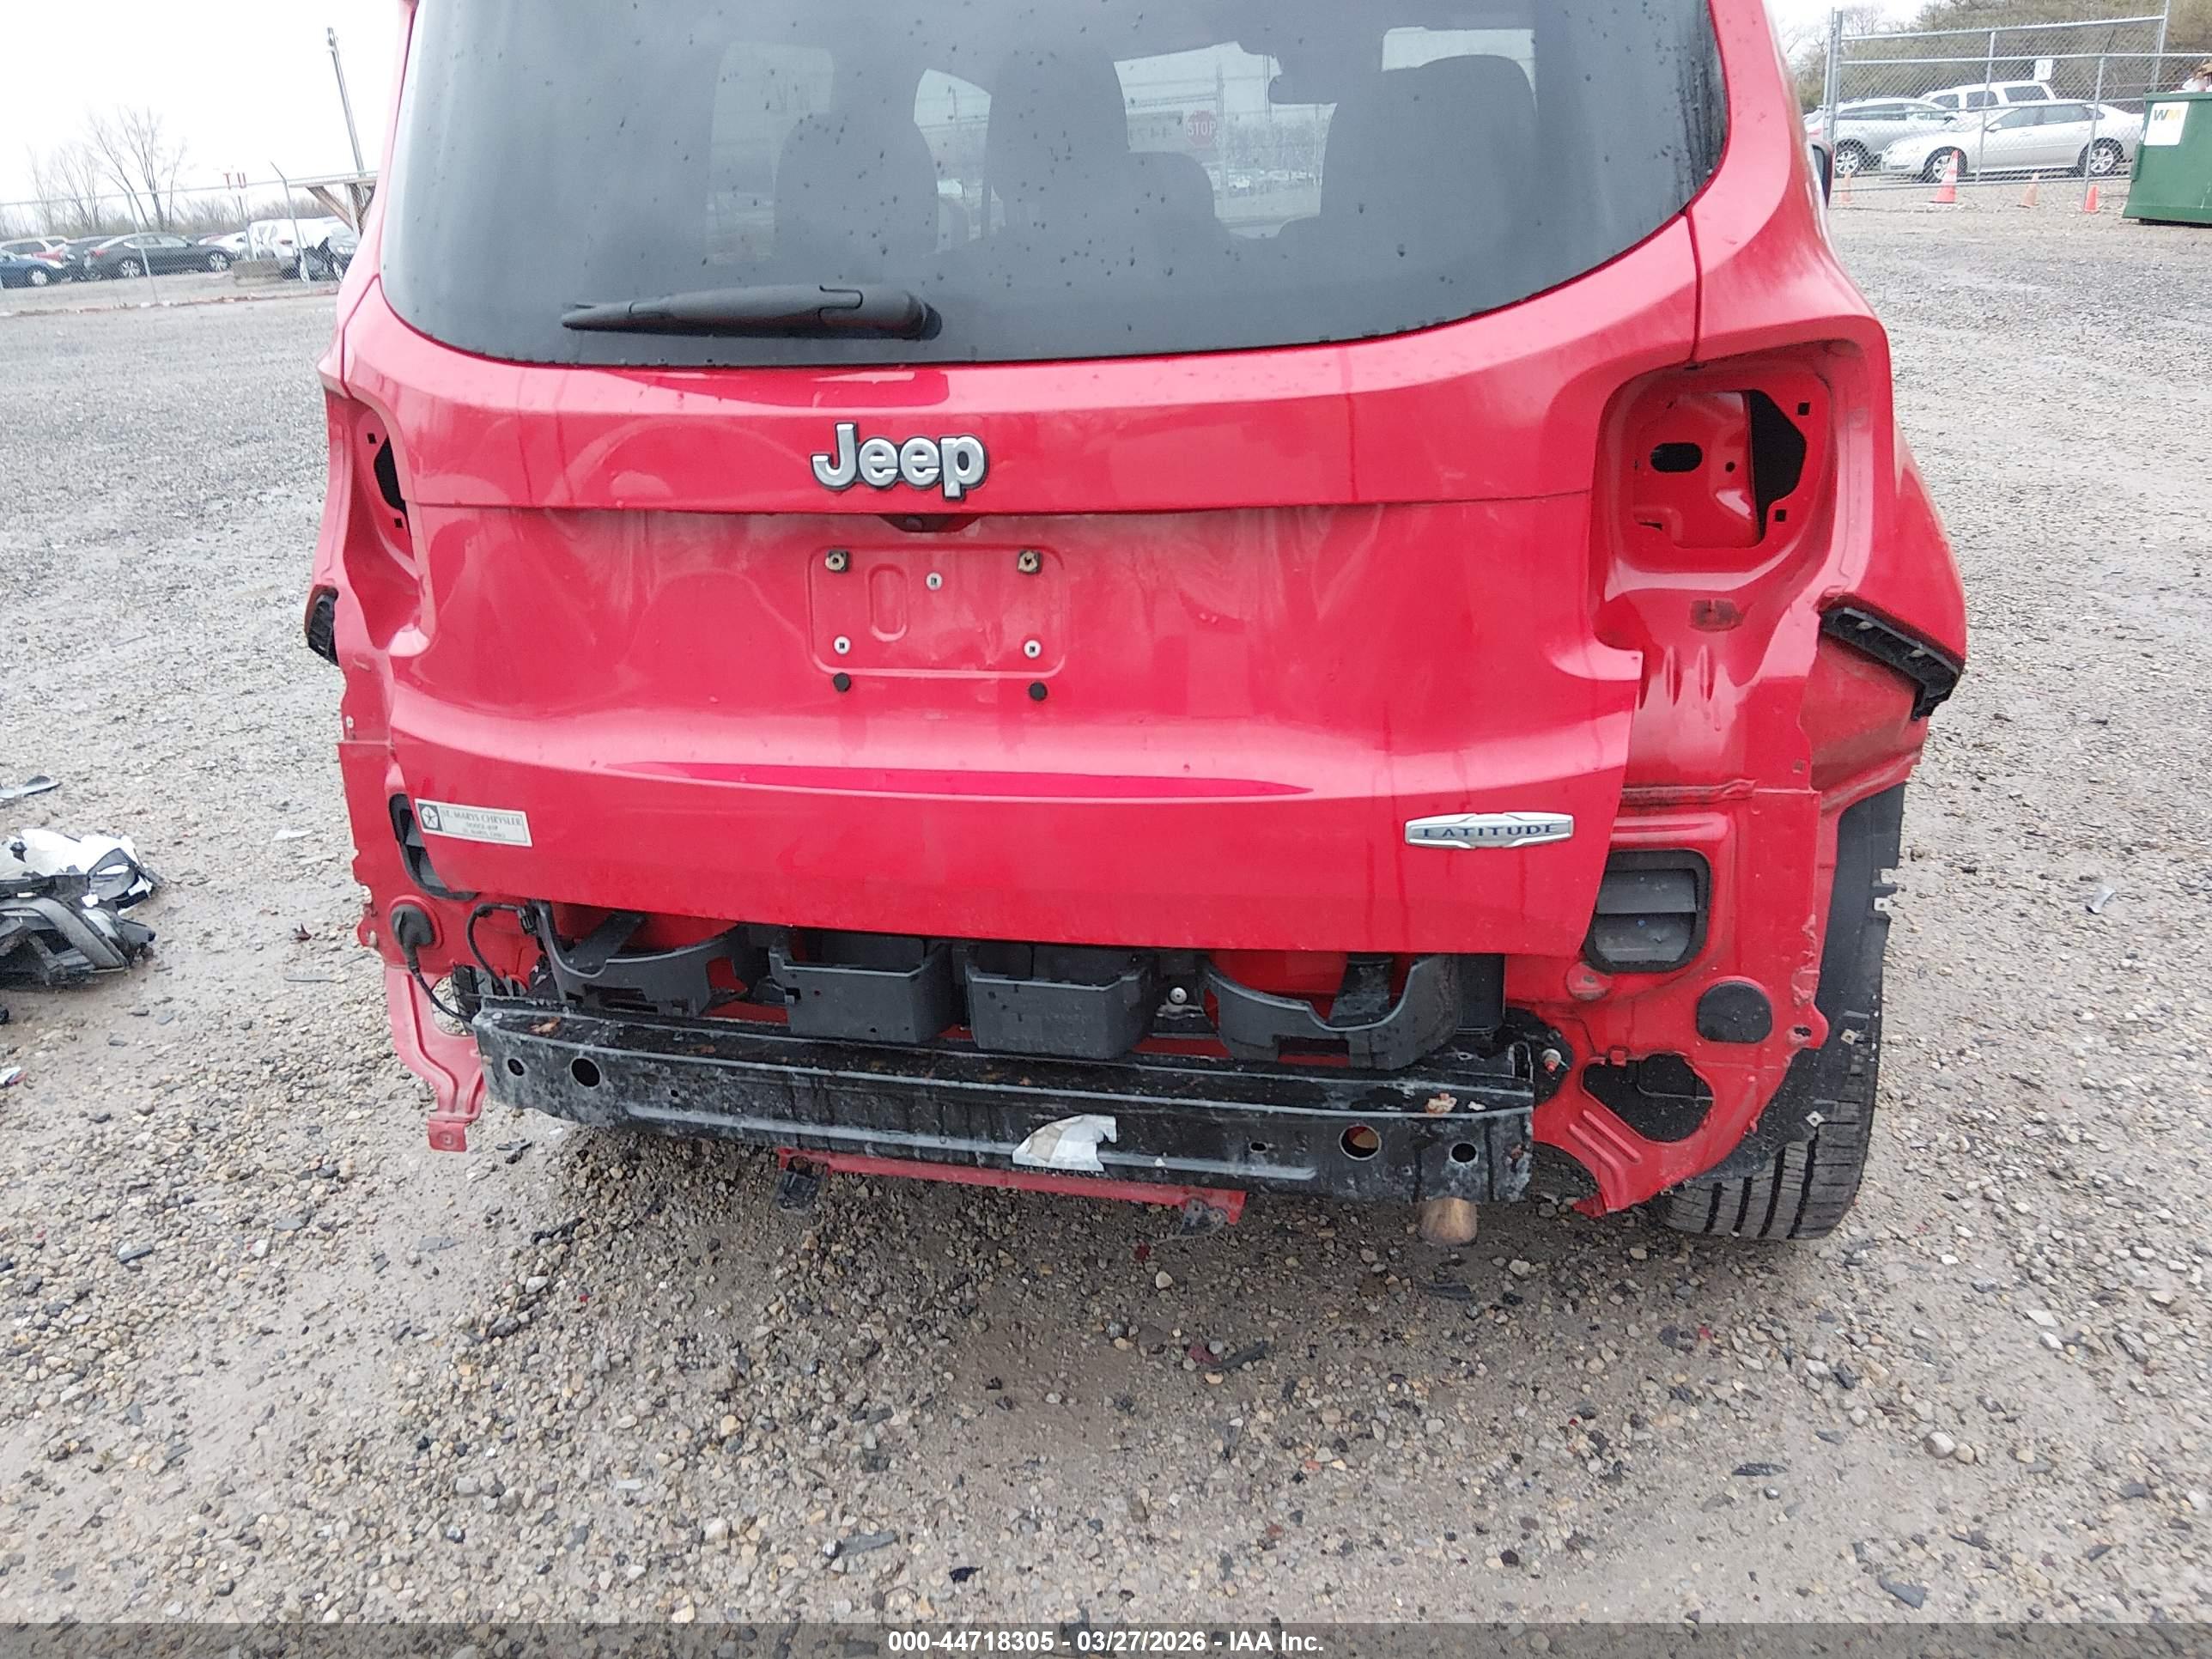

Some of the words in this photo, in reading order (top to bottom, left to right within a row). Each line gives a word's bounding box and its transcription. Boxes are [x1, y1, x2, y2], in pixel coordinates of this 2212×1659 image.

[2154, 109, 2181, 121] WM
[1188, 123, 1217, 137] STOP
[811, 422, 988, 499] Jeep
[481, 813, 522, 825] CHRYSLER
[1424, 823, 1559, 838] LATITUDE
